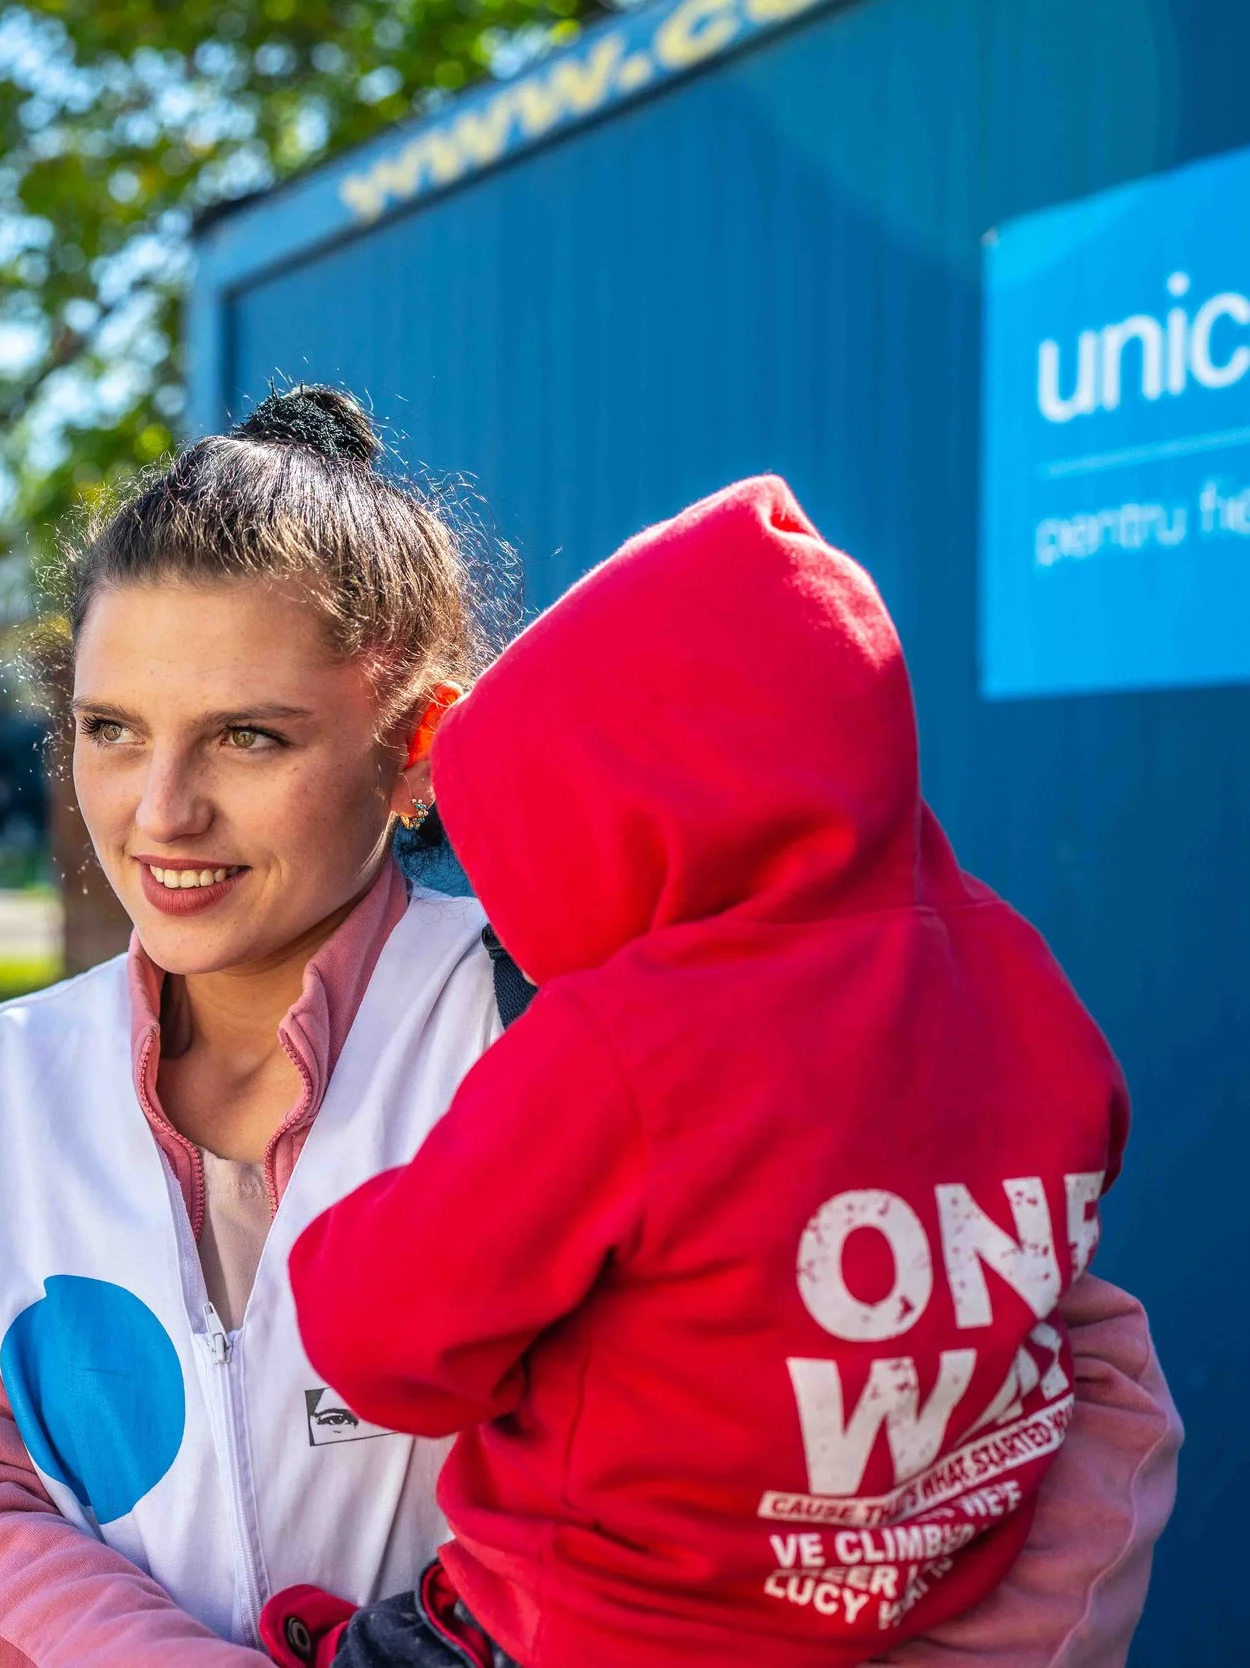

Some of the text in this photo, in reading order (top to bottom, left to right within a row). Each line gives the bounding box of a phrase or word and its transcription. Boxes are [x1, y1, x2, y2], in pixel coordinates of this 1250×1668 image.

[339, 0, 816, 222] www.c
[1036, 503, 1187, 566] pentru
[771, 1496, 853, 1519] CAUSE
